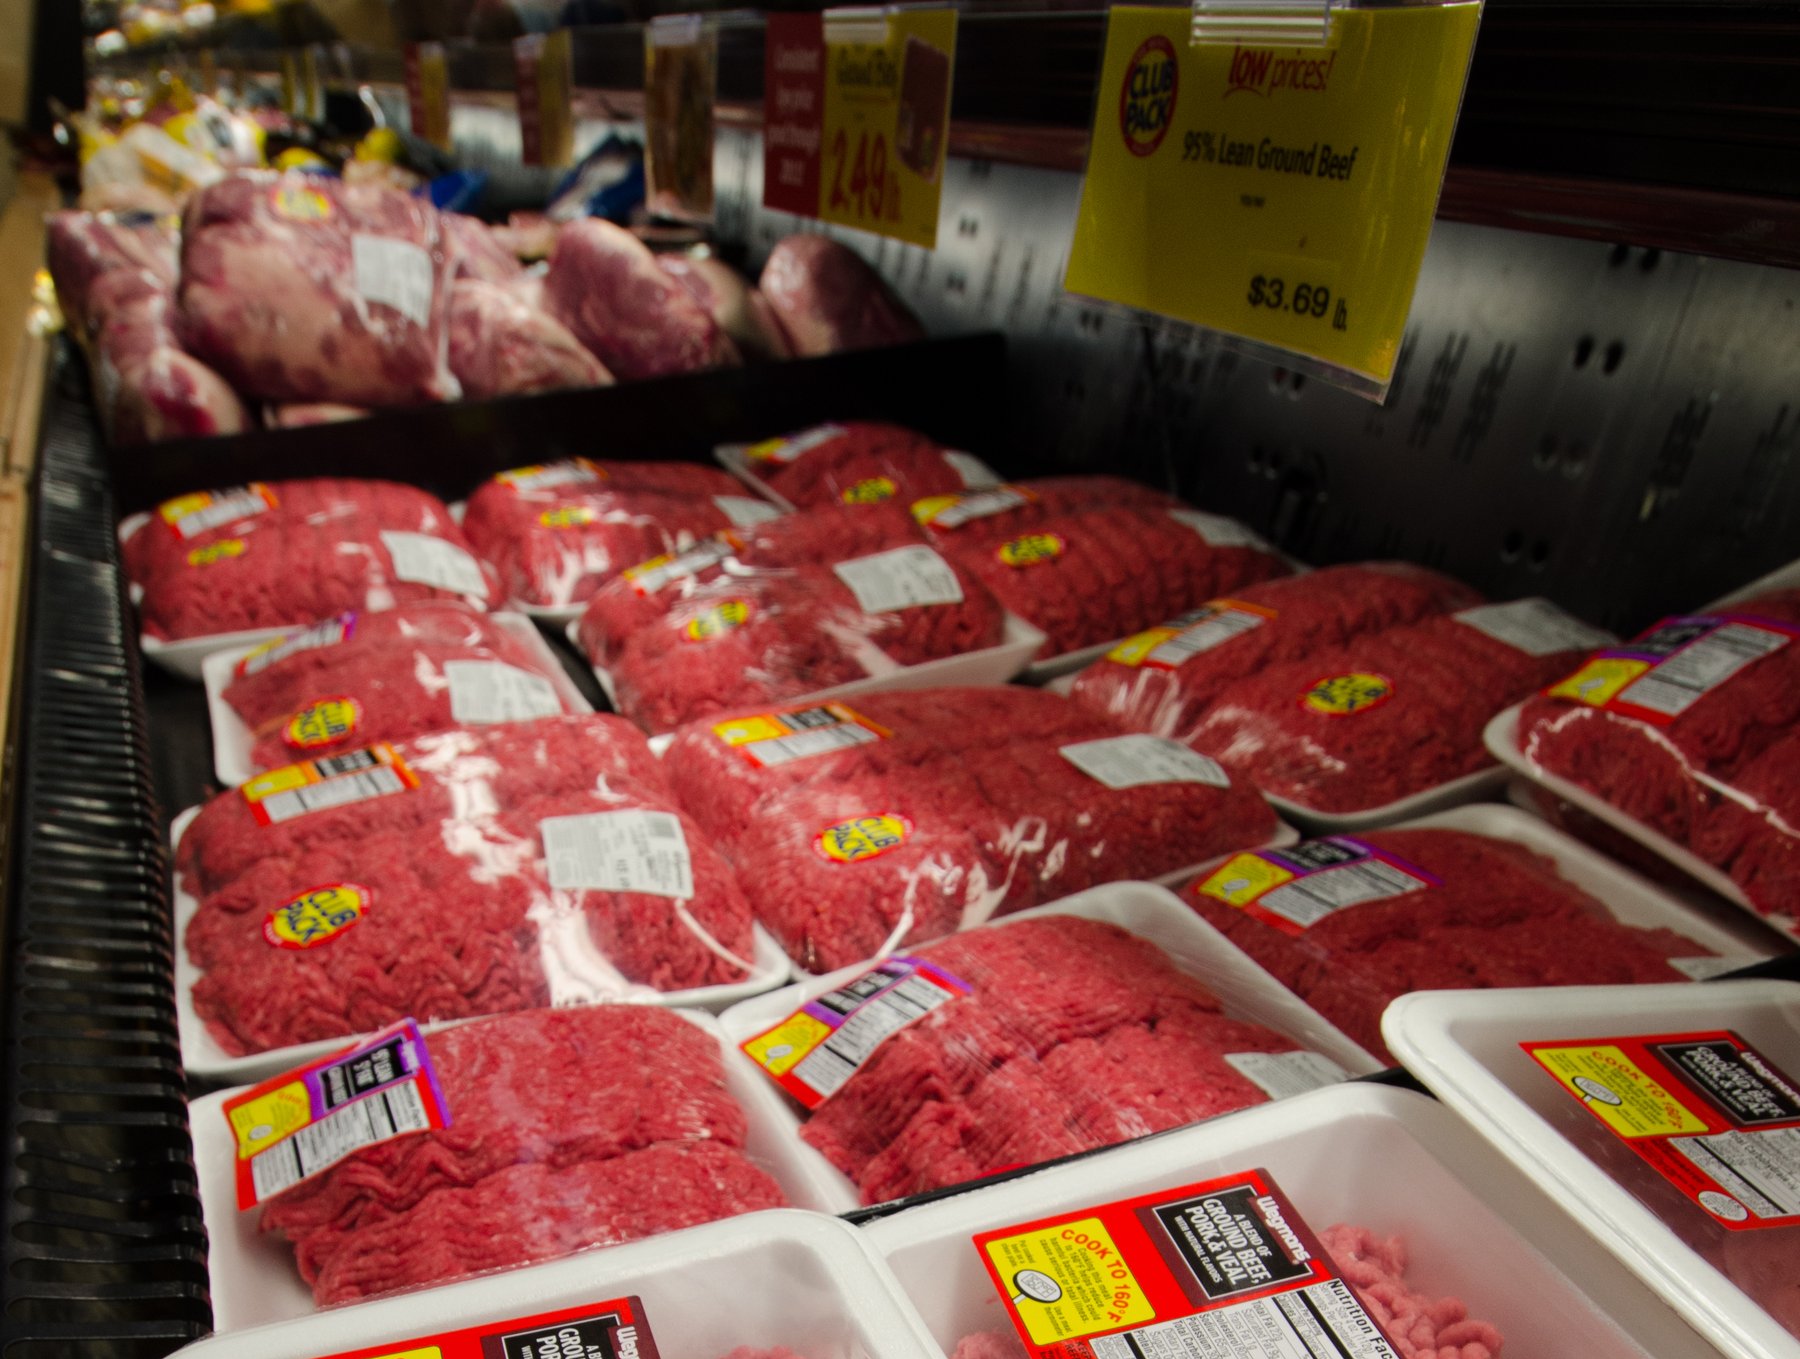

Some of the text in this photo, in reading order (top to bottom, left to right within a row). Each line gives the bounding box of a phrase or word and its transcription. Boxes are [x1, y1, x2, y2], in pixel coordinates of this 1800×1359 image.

[1130, 59, 1174, 99] CLUB
[1228, 44, 1337, 97] low prices!
[1126, 96, 1170, 135] PACK
[1182, 130, 1359, 180] 95% Lean Ground Beef
[1248, 274, 1329, 318] $3.69
[284, 901, 327, 942] PACK
[309, 889, 357, 926] CLUB
[1172, 1215, 1224, 1282] WITH NATURAL FLAVORS
[1200, 1197, 1273, 1284] GROUND BEEF,
[1232, 1212, 1273, 1257] A BLEND OF
[1257, 1197, 1313, 1265] Wegmans
[1061, 1228, 1108, 1258] COOK
[1105, 1257, 1128, 1280] TO
[1213, 1250, 1250, 1284] VEAL
[1326, 1279, 1374, 1334] Nutrition
[520, 1345, 533, 1359] WITH
[585, 1343, 599, 1351] A
